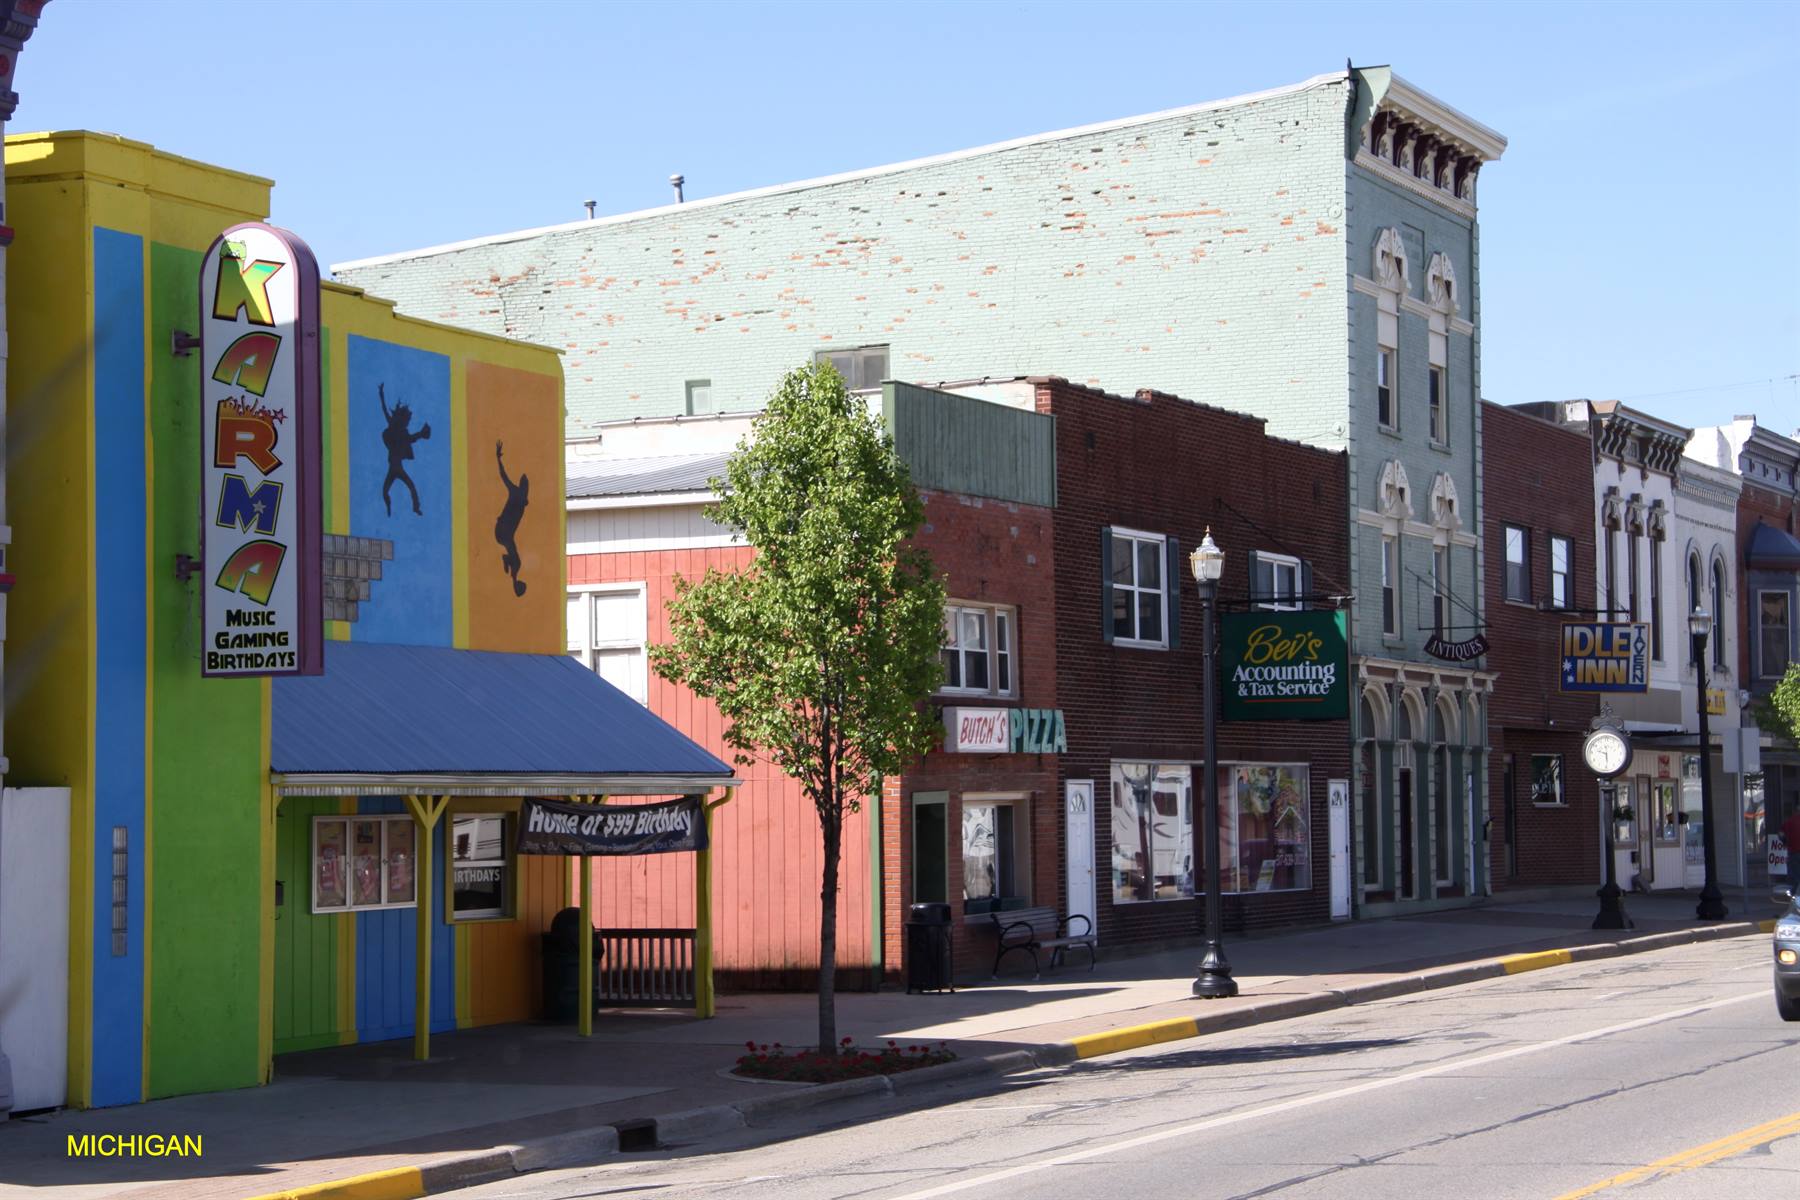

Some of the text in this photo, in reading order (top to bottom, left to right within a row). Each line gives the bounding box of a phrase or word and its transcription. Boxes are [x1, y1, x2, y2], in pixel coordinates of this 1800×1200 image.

[212, 257, 288, 607] KARMA
[1243, 624, 1322, 664] Bev's
[1429, 639, 1484, 661] ANTIQUES
[1564, 626, 1631, 657] IDLE
[1632, 625, 1646, 683] TAVERN
[1231, 660, 1335, 685] Accounting
[1576, 658, 1627, 684] INN
[1238, 680, 1330, 696] & Tax Service
[960, 708, 1067, 753] BUTCH'S PIZZA
[528, 804, 577, 834] Home
[1770, 839, 1787, 850] No
[1768, 853, 1787, 866] Ope
[454, 869, 501, 882] IRTHDAYS
